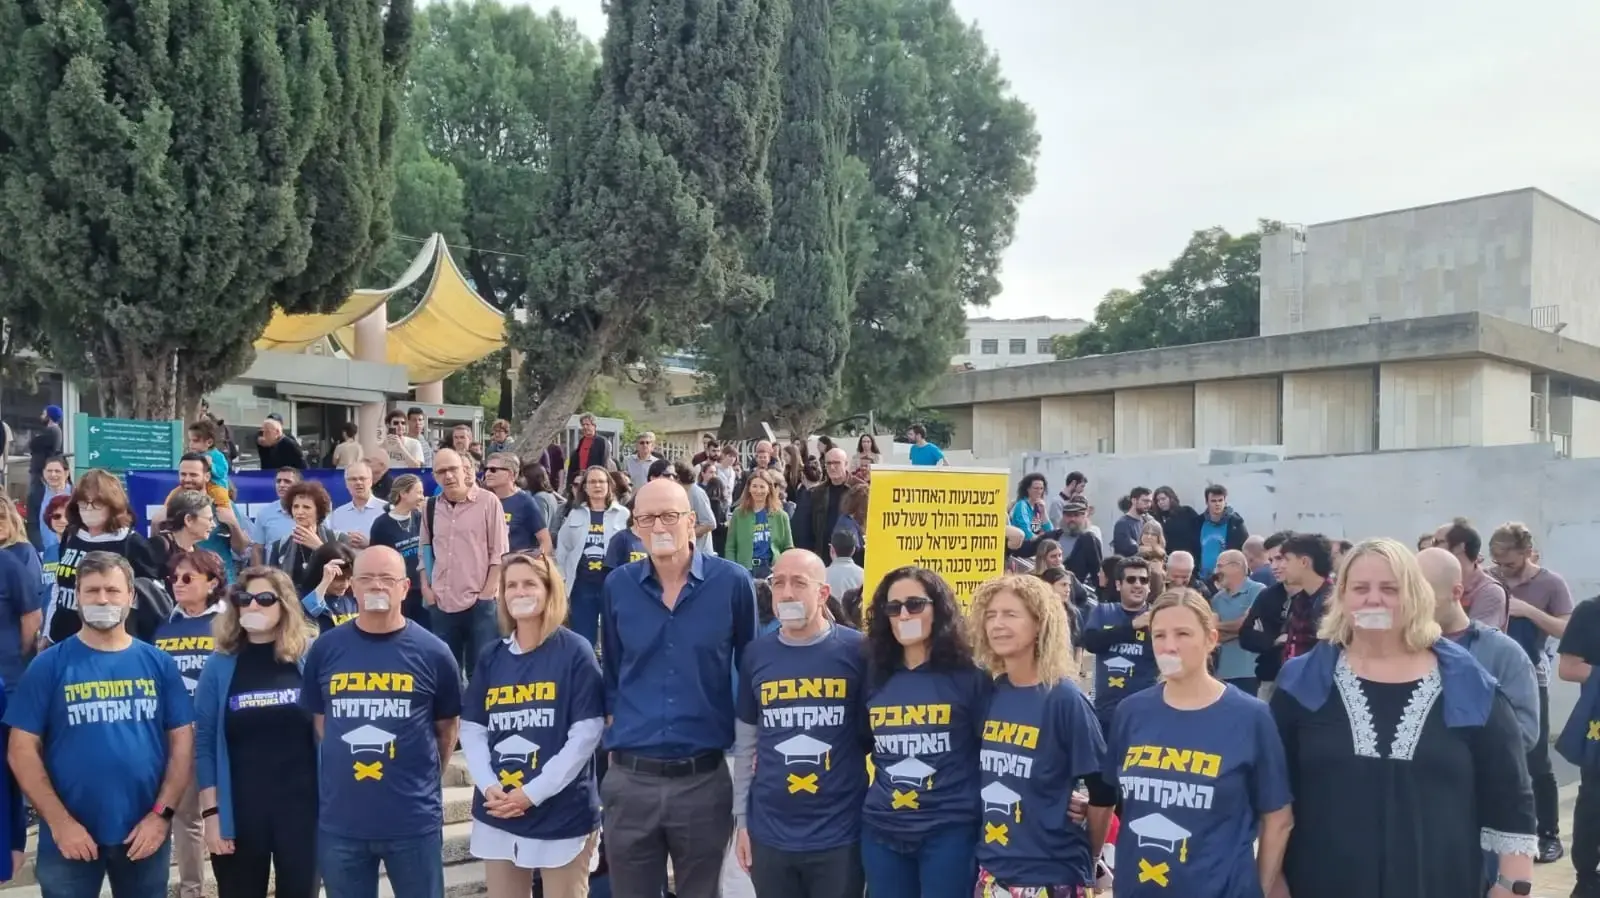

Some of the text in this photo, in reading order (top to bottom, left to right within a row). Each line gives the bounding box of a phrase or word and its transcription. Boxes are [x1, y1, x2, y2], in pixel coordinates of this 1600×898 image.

[892, 487, 946, 504] האחרונים
[882, 508, 999, 530] מתבהר והולך ששלטון
[896, 532, 997, 552] החוק בישראל עומד
[945, 557, 970, 573] סכנה
[974, 558, 996, 572] בפני
[64, 678, 157, 702] בלי דמוקרטיה
[330, 672, 414, 695] מאבק
[484, 681, 556, 711] מאבק
[761, 677, 847, 705] מאבק
[67, 699, 157, 725] אין אקדמיה
[331, 698, 411, 720] האקדמיה
[763, 705, 845, 730] האקדמיה
[869, 703, 952, 731] מאבק
[874, 732, 952, 758] האקדמיה
[983, 720, 1040, 749] מאב
[1122, 745, 1222, 777] מאבק
[1119, 776, 1215, 809] האקדמיה
